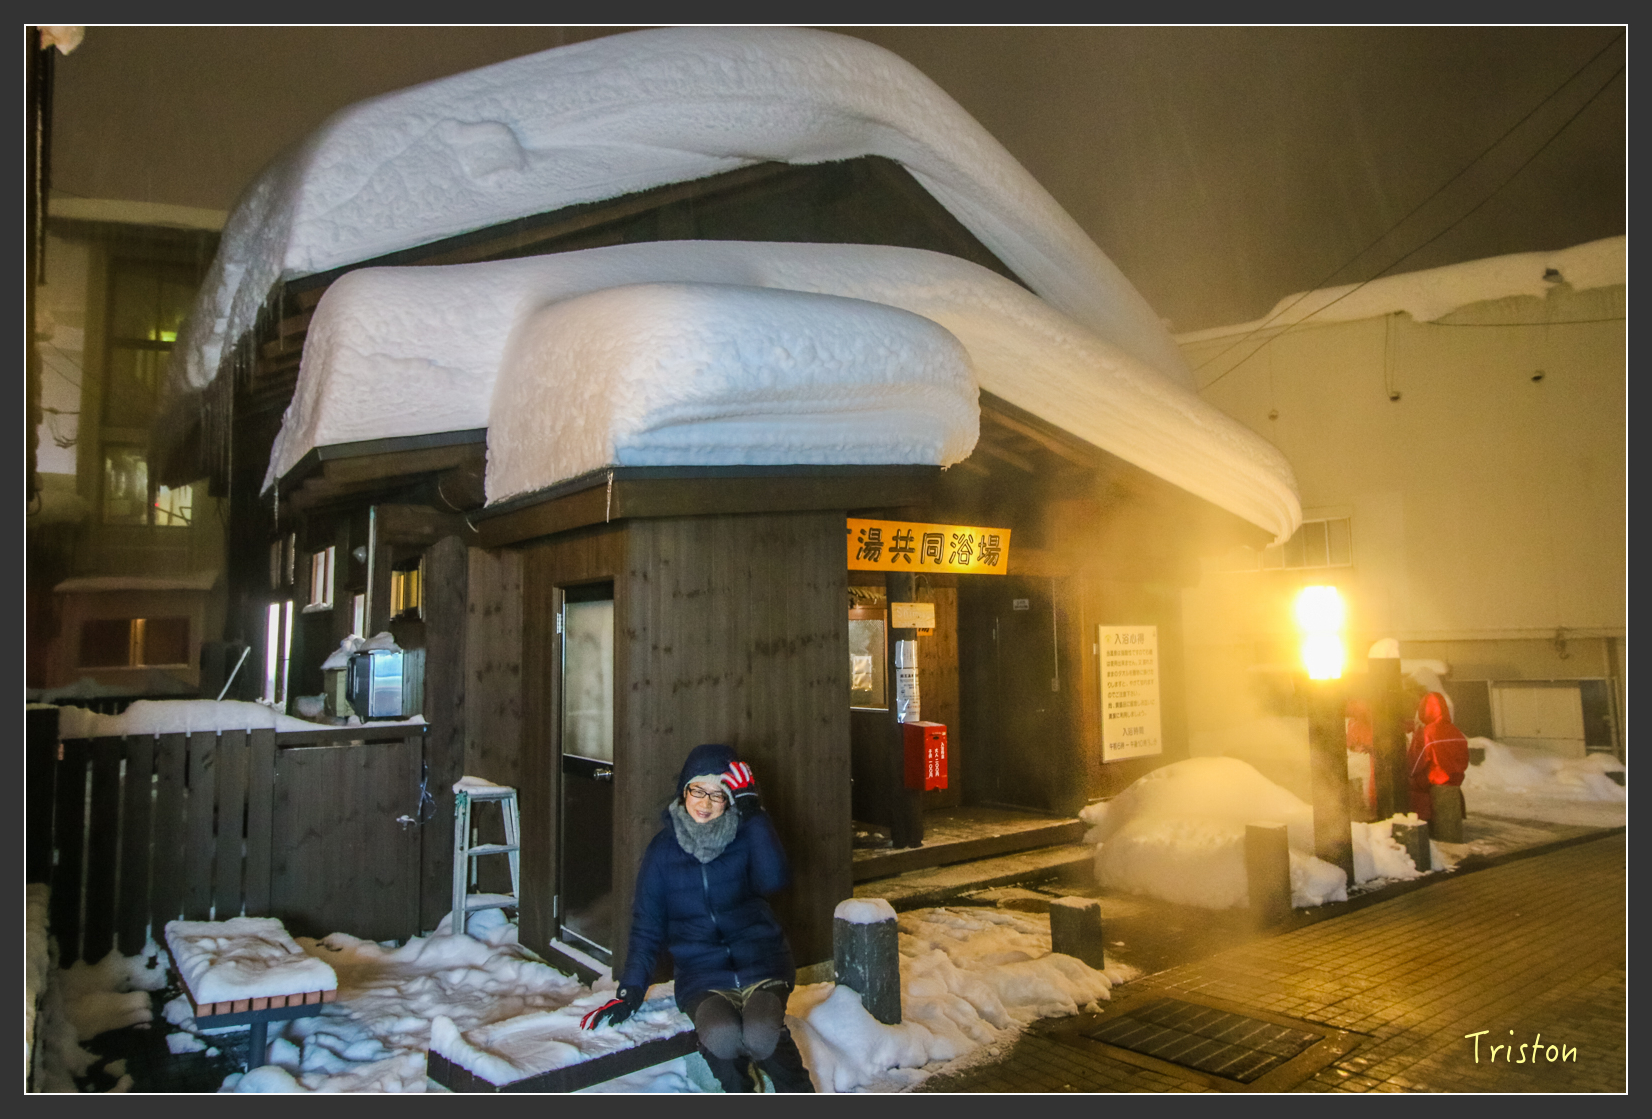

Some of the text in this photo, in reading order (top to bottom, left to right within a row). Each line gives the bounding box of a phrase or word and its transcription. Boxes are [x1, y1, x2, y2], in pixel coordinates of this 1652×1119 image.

[847, 527, 1001, 567] 湯共同浴場
[1114, 633, 1144, 645] 入浴心得
